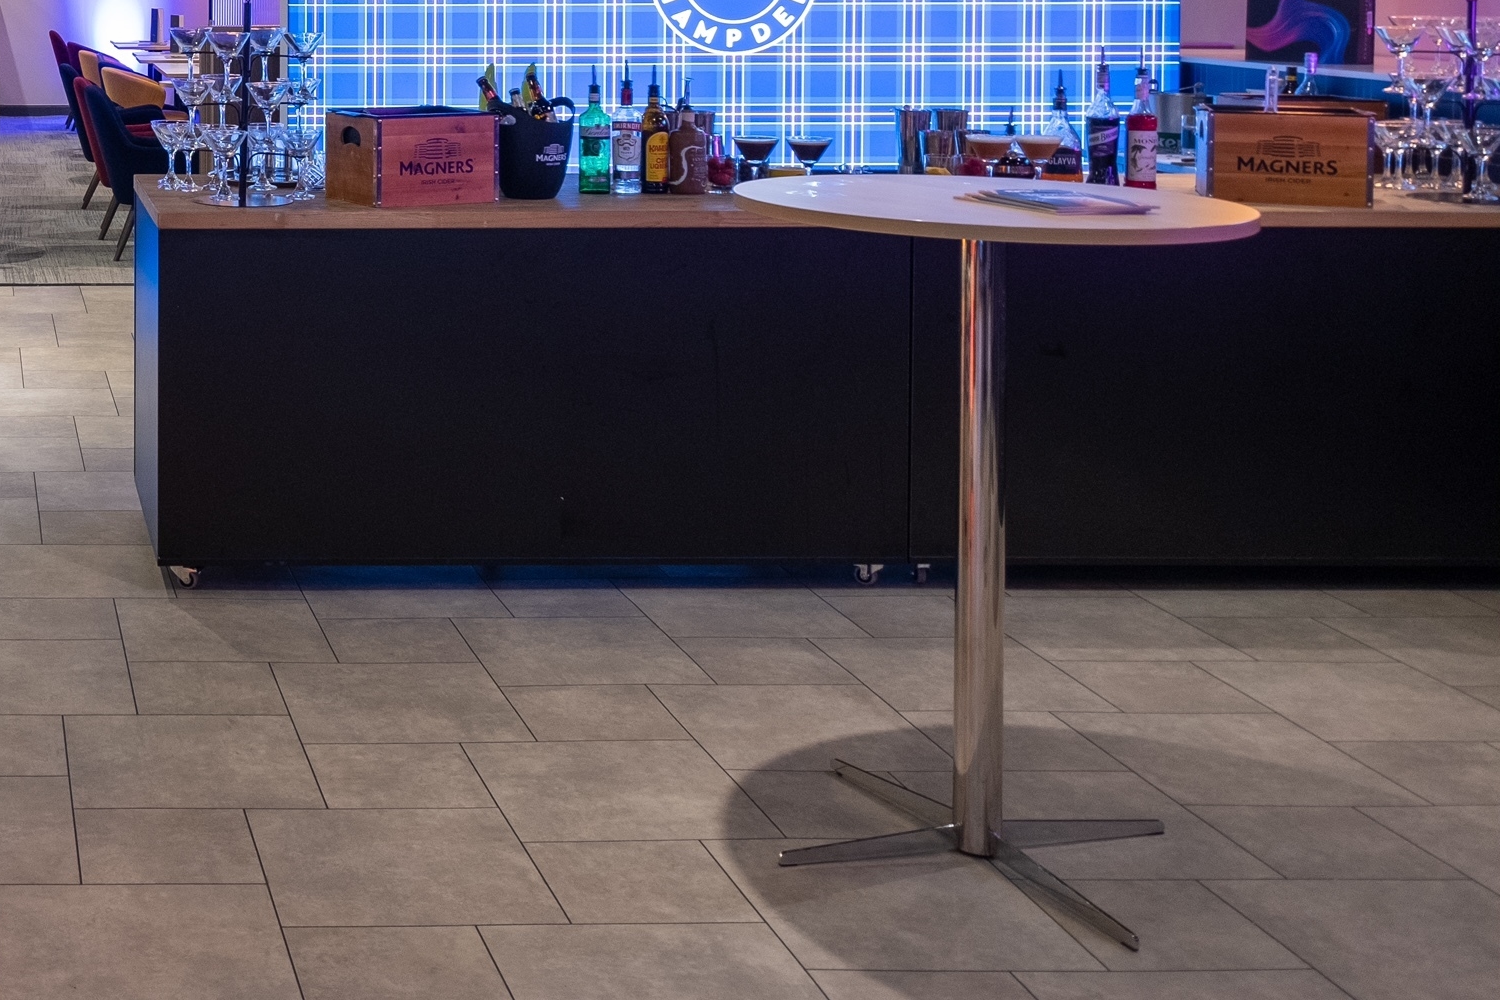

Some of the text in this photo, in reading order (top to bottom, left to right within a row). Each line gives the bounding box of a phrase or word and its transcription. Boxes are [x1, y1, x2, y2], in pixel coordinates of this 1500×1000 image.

[399, 158, 475, 177] MAGNERS
[1048, 156, 1077, 166] GLAYVA
[1236, 155, 1339, 176] MAGNERS
